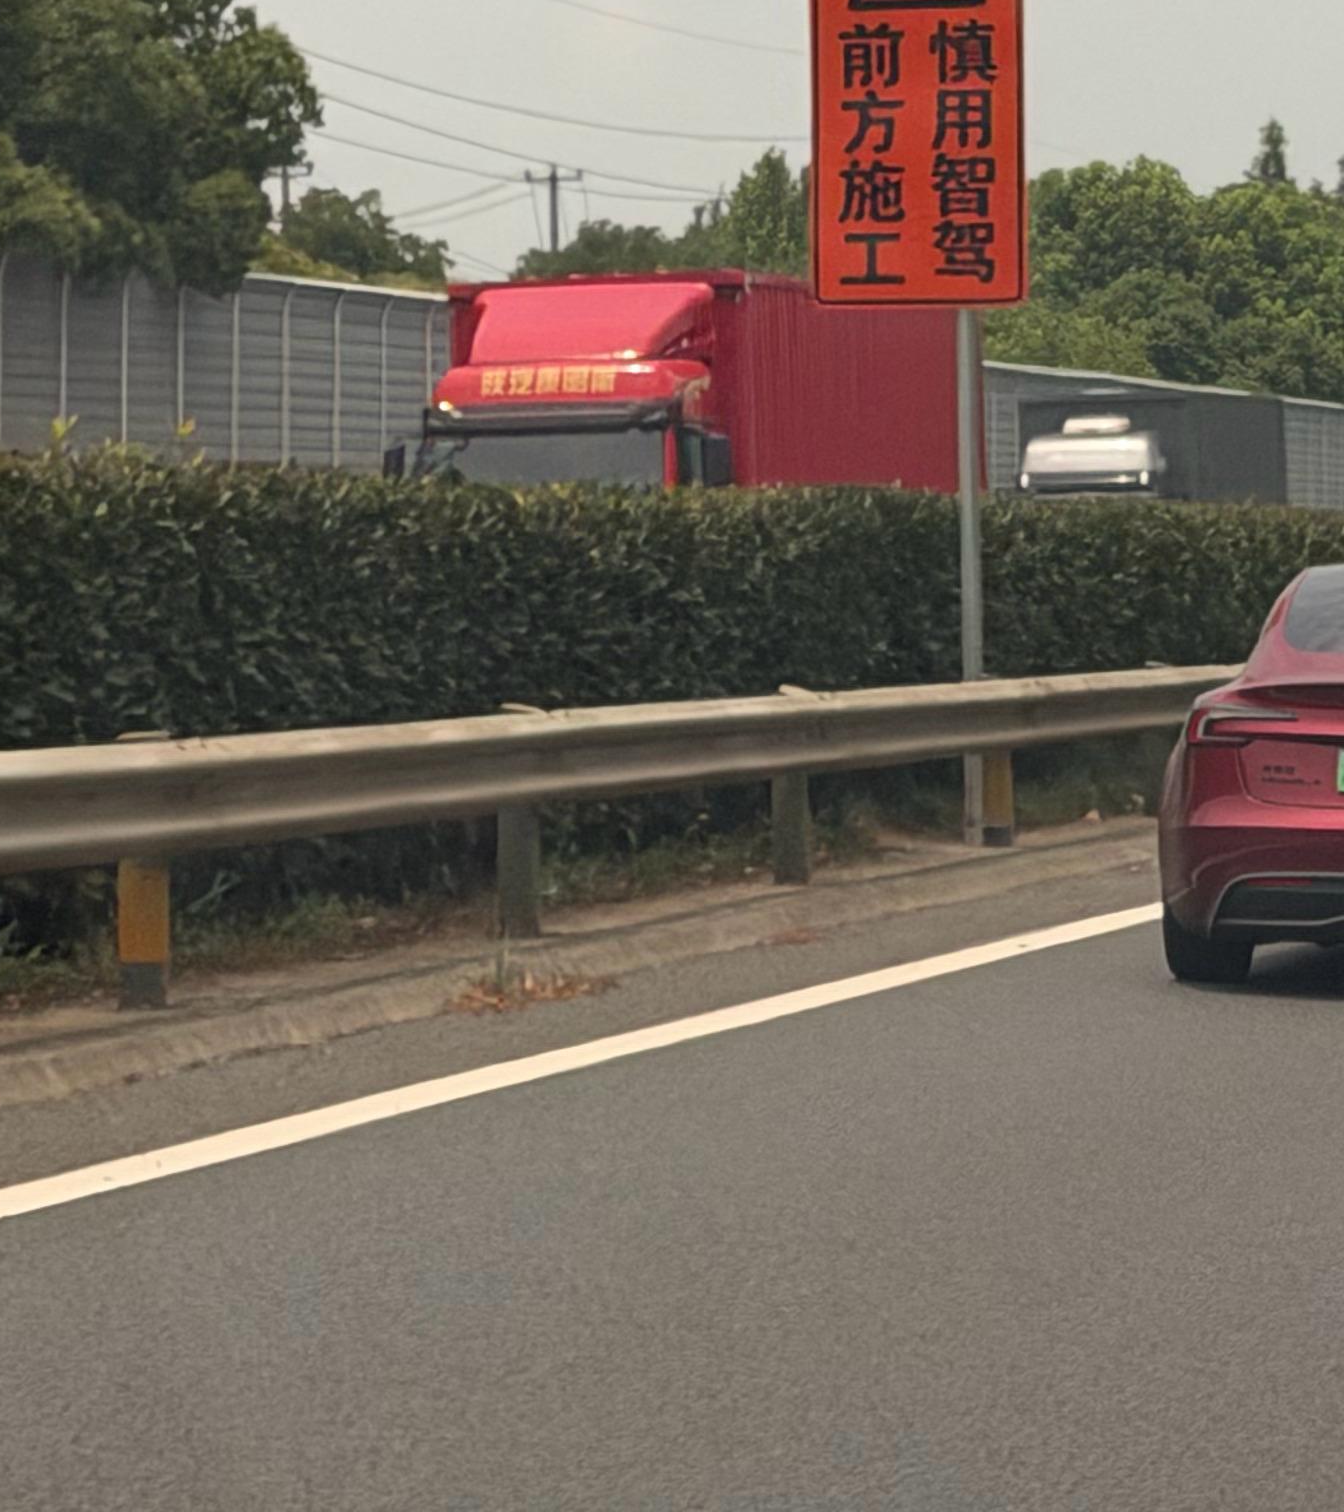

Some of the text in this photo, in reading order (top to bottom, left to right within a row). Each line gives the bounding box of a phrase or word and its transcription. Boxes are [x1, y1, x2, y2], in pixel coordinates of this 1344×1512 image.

[838, 23, 906, 286] 前方施工
[928, 19, 998, 284] 慎用智驾
